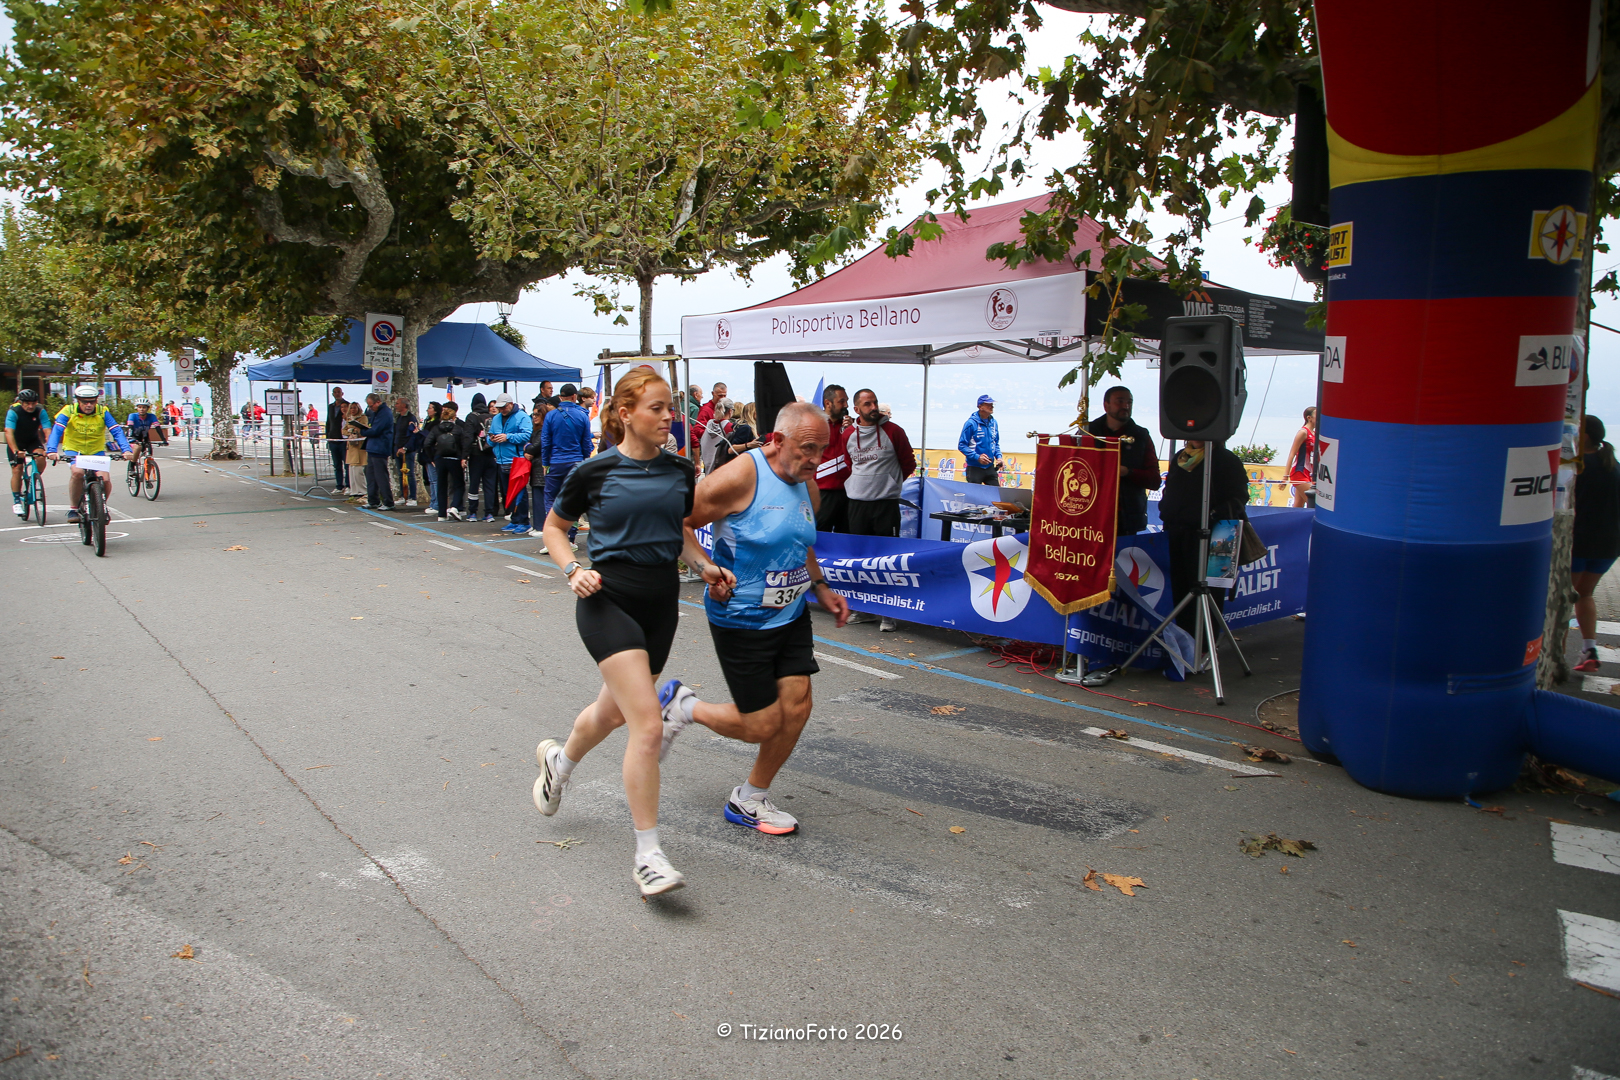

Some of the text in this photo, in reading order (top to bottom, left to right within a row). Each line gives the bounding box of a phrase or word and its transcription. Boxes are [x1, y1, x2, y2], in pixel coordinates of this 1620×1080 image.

[1218, 303, 1245, 314] TECNOLOGIA
[772, 305, 921, 338] Polisportiva Bellano
[1552, 346, 1571, 370] BL
[1063, 500, 1084, 510] Bellano
[1040, 519, 1104, 543] Polisportiva
[1045, 544, 1096, 567] Bellano
[1054, 572, 1080, 582] 1974
[1222, 600, 1281, 623] specialist.it
